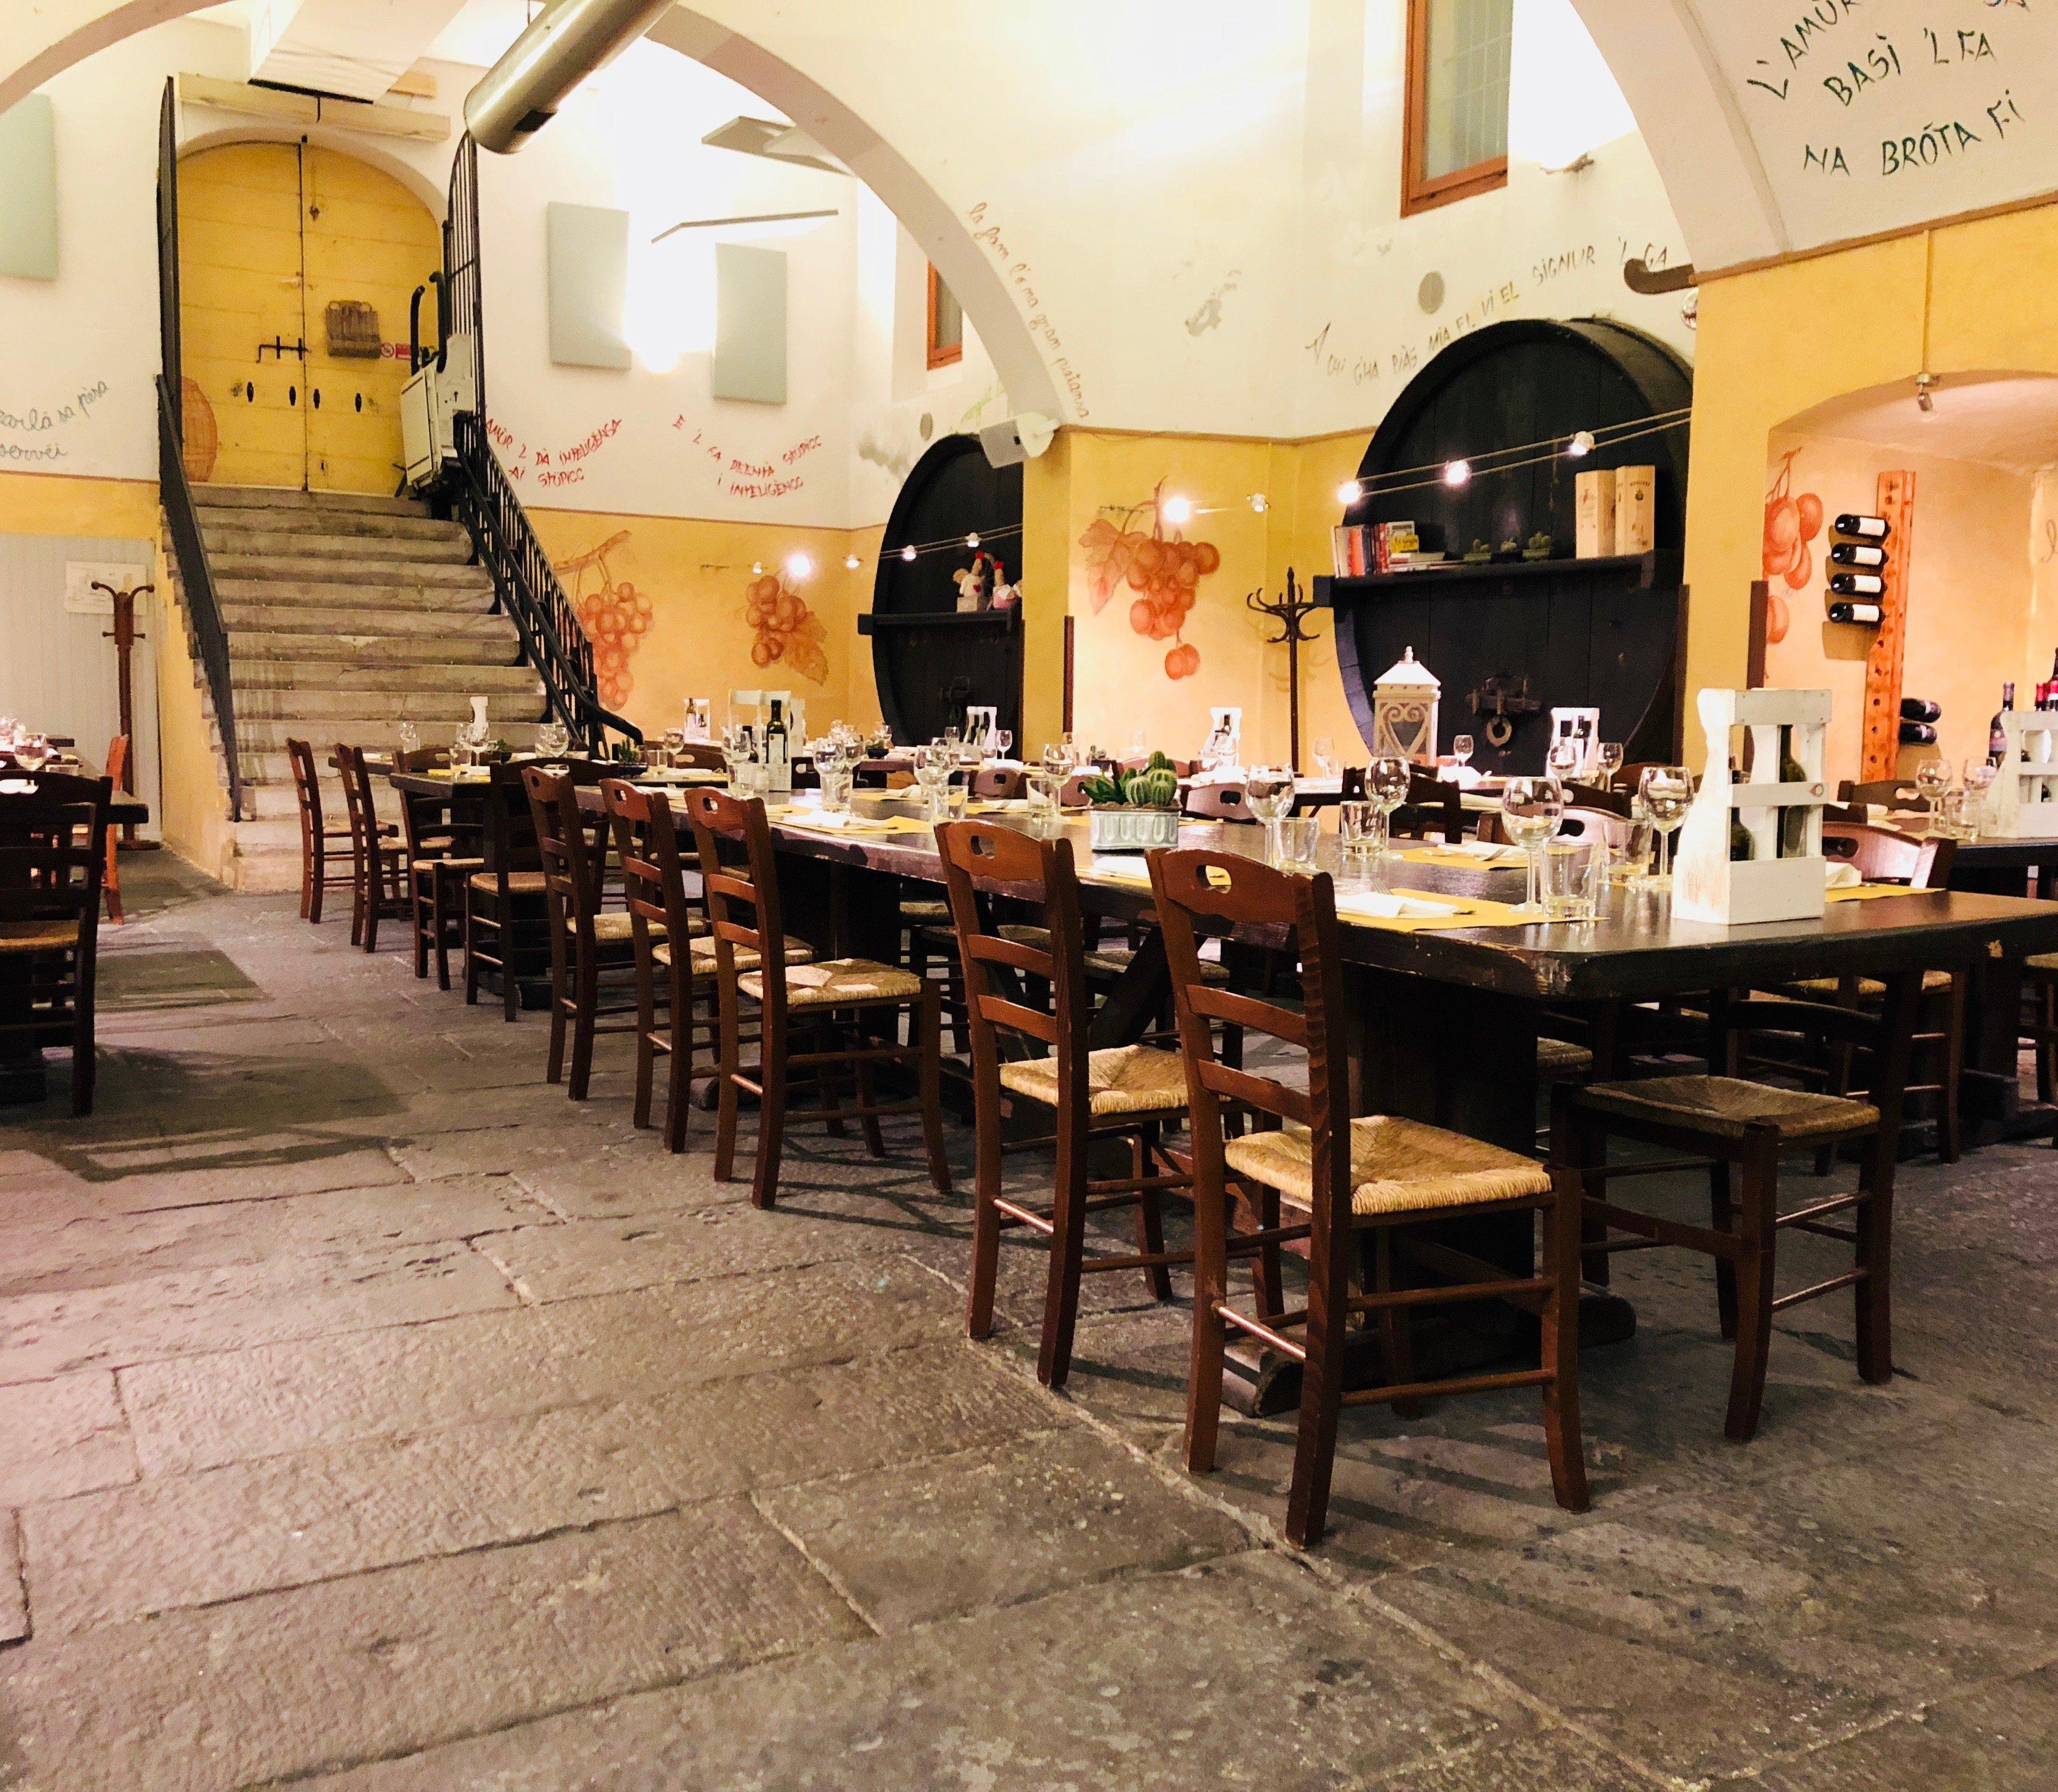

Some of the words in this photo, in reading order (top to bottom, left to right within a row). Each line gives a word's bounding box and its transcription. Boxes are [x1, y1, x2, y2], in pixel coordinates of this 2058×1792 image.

[1957, 30, 1997, 62] FA
[1803, 144, 1850, 177] NA
[1500, 280, 1521, 304] EL
